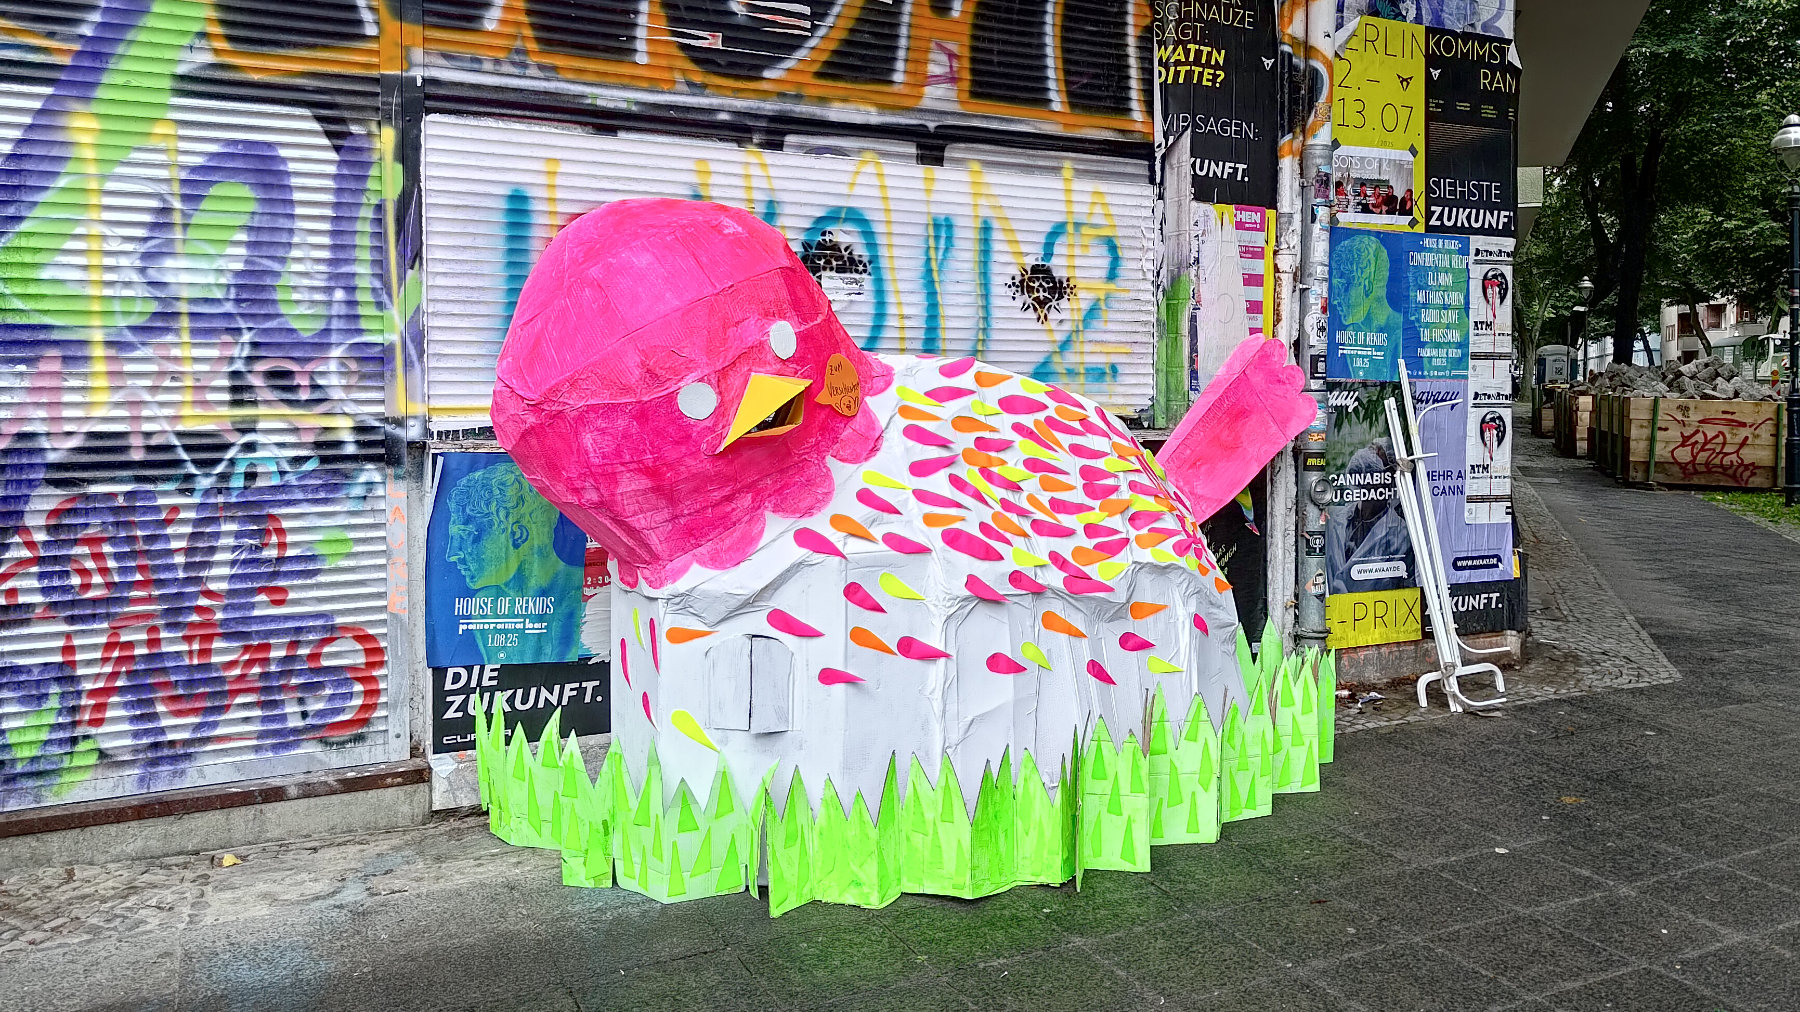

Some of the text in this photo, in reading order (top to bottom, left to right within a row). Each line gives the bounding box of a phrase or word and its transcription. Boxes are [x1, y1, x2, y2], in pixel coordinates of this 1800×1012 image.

[1154, 1, 1255, 30] SCHNAUZE
[1154, 22, 1210, 42] SAGT:
[1156, 43, 1226, 67] WATTN
[1337, 97, 1421, 136] 13.07.
[1195, 114, 1260, 141] SAGEN:
[1429, 177, 1501, 203] SIEHSTE
[1409, 251, 1470, 270] CONFIDENTIAL RECIP
[1416, 289, 1444, 305] MATHIAS
[1421, 308, 1440, 323] RADIO
[1473, 320, 1493, 331] ATM
[1336, 330, 1357, 345] HOUSE
[1357, 331, 1366, 345] OF
[1469, 463, 1490, 475] ATM
[1328, 473, 1392, 487] CANNABIS
[1432, 485, 1465, 497] CANN
[1356, 565, 1401, 576] WWW.AVAAY.DE
[1456, 557, 1498, 568] WWW.AVAAY.DE
[454, 596, 555, 617] HOUSE OF REKIDS
[458, 617, 548, 635] panorama bar
[486, 633, 519, 648] 1.08.25
[443, 665, 501, 692] DIE
[441, 680, 604, 721] ZUKUNFT.
